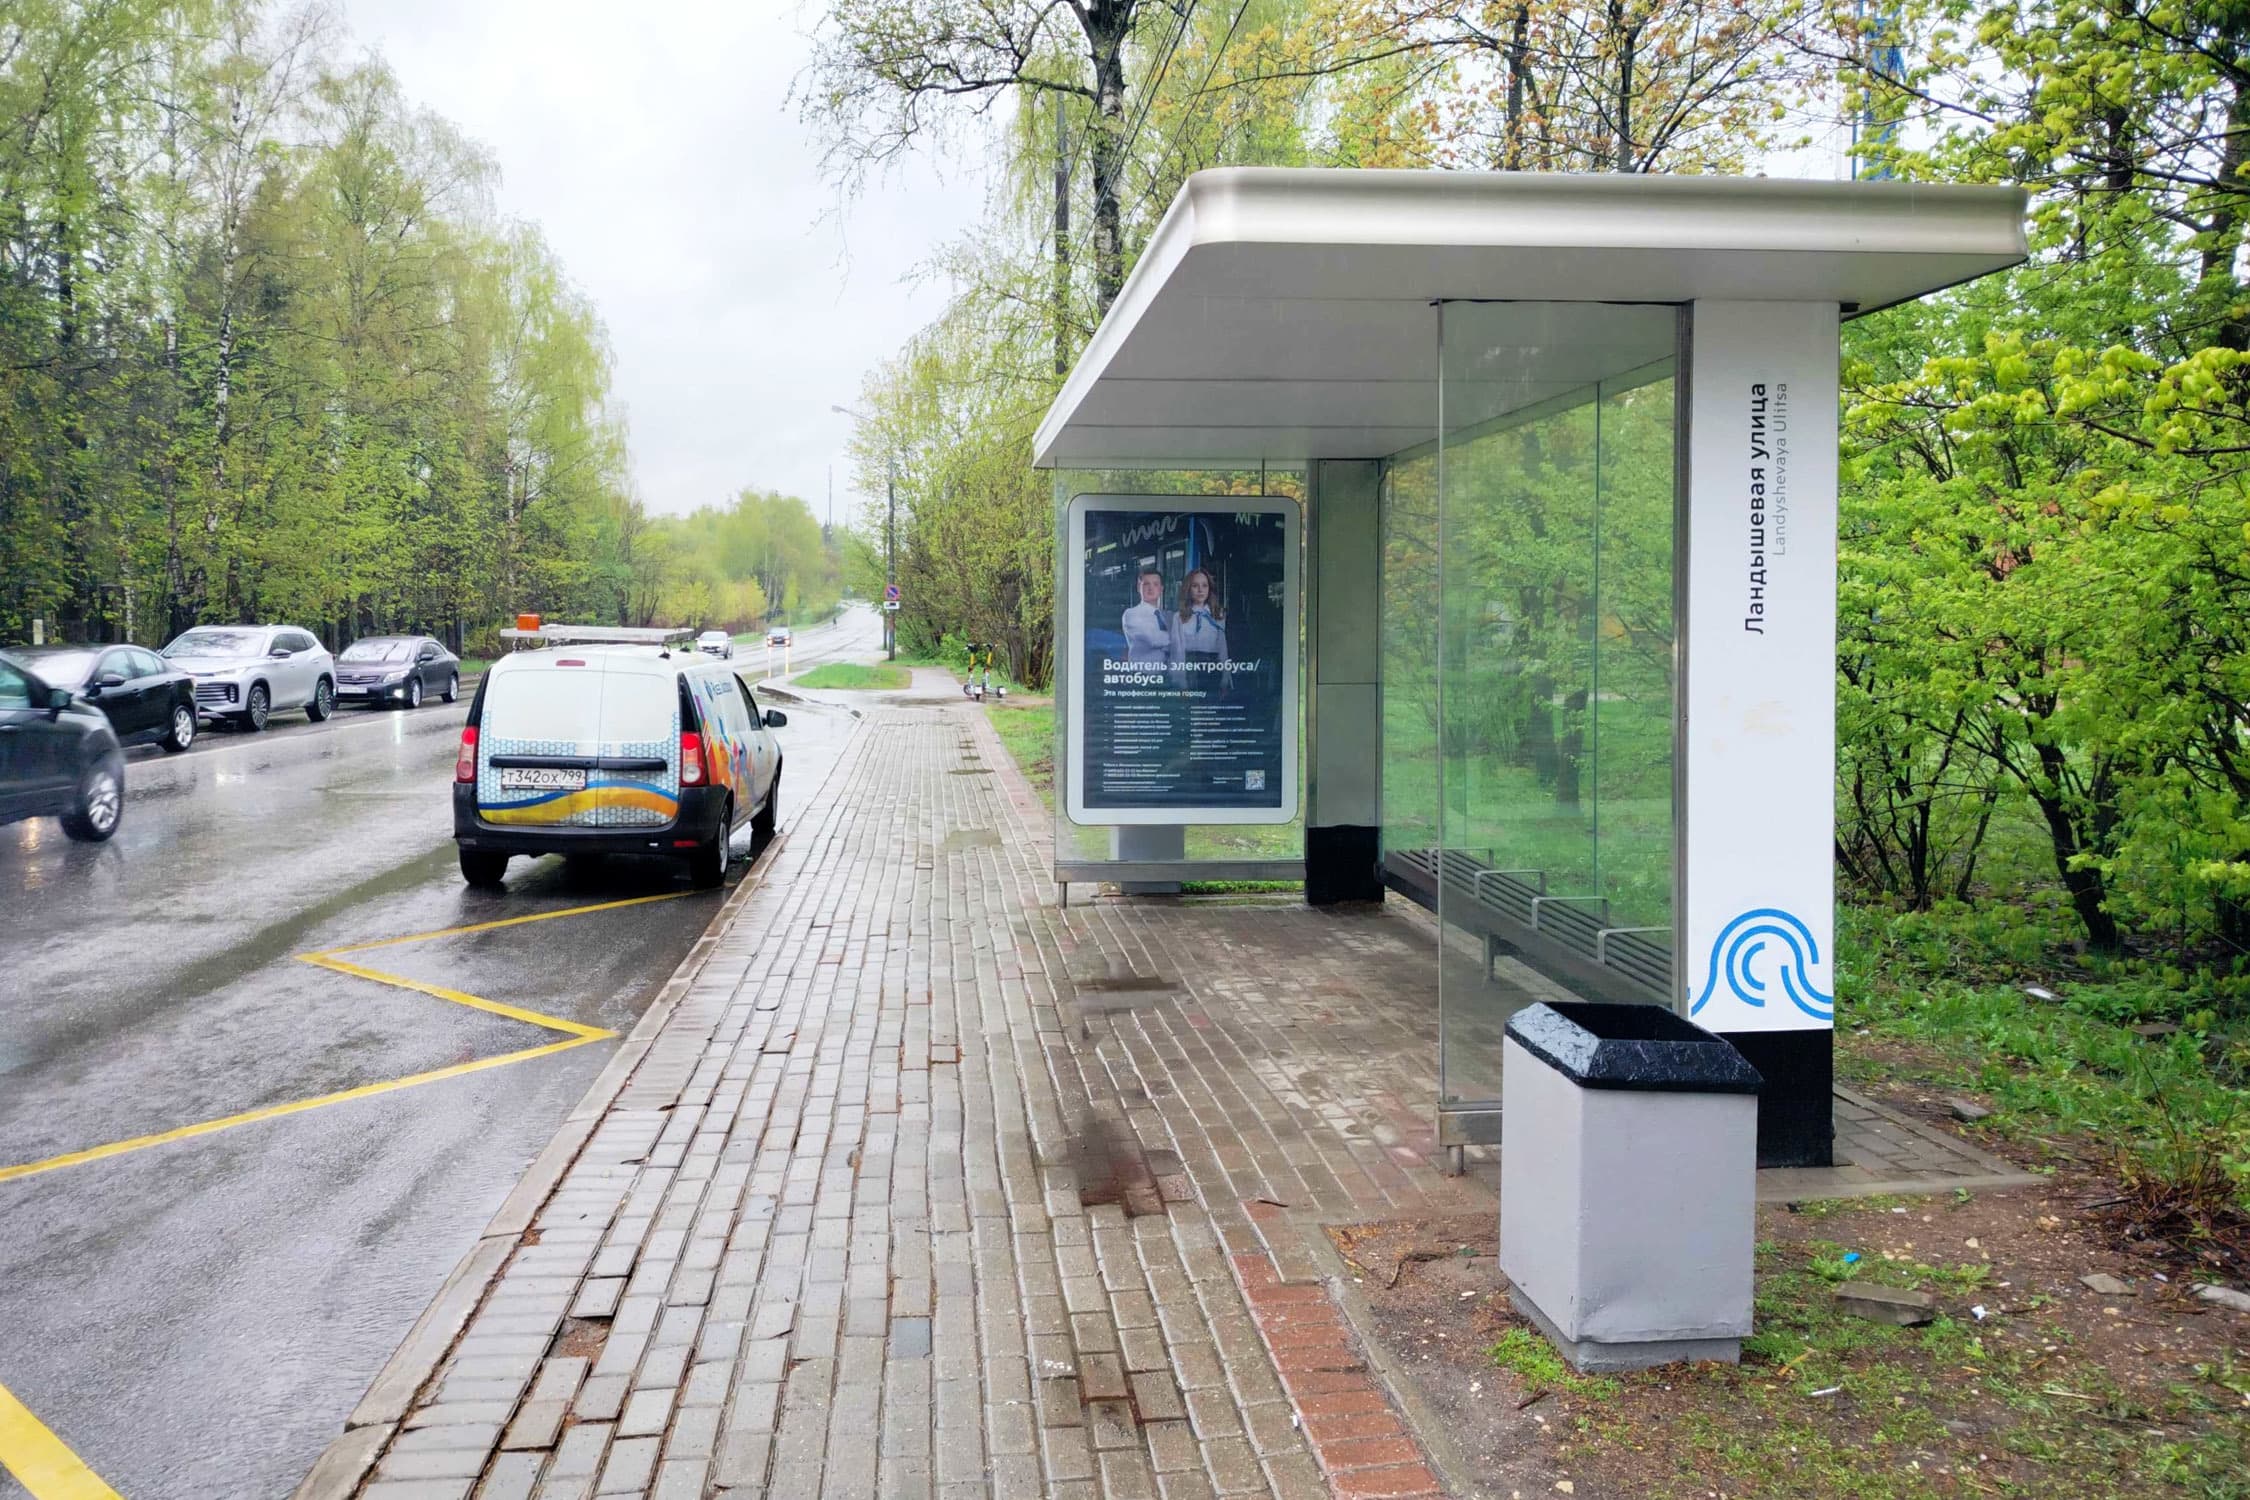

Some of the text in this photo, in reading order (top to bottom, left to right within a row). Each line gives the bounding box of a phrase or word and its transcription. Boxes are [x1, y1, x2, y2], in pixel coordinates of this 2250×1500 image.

[1771, 383, 1789, 555] Landyshevaya Ulitsa
[1744, 383, 1770, 635] Ландышевая улица
[1103, 658, 1261, 674] Водитель электробуса/
[1103, 672, 1164, 687] автобуса
[1103, 689, 1207, 698] Эта профессия нужна городу
